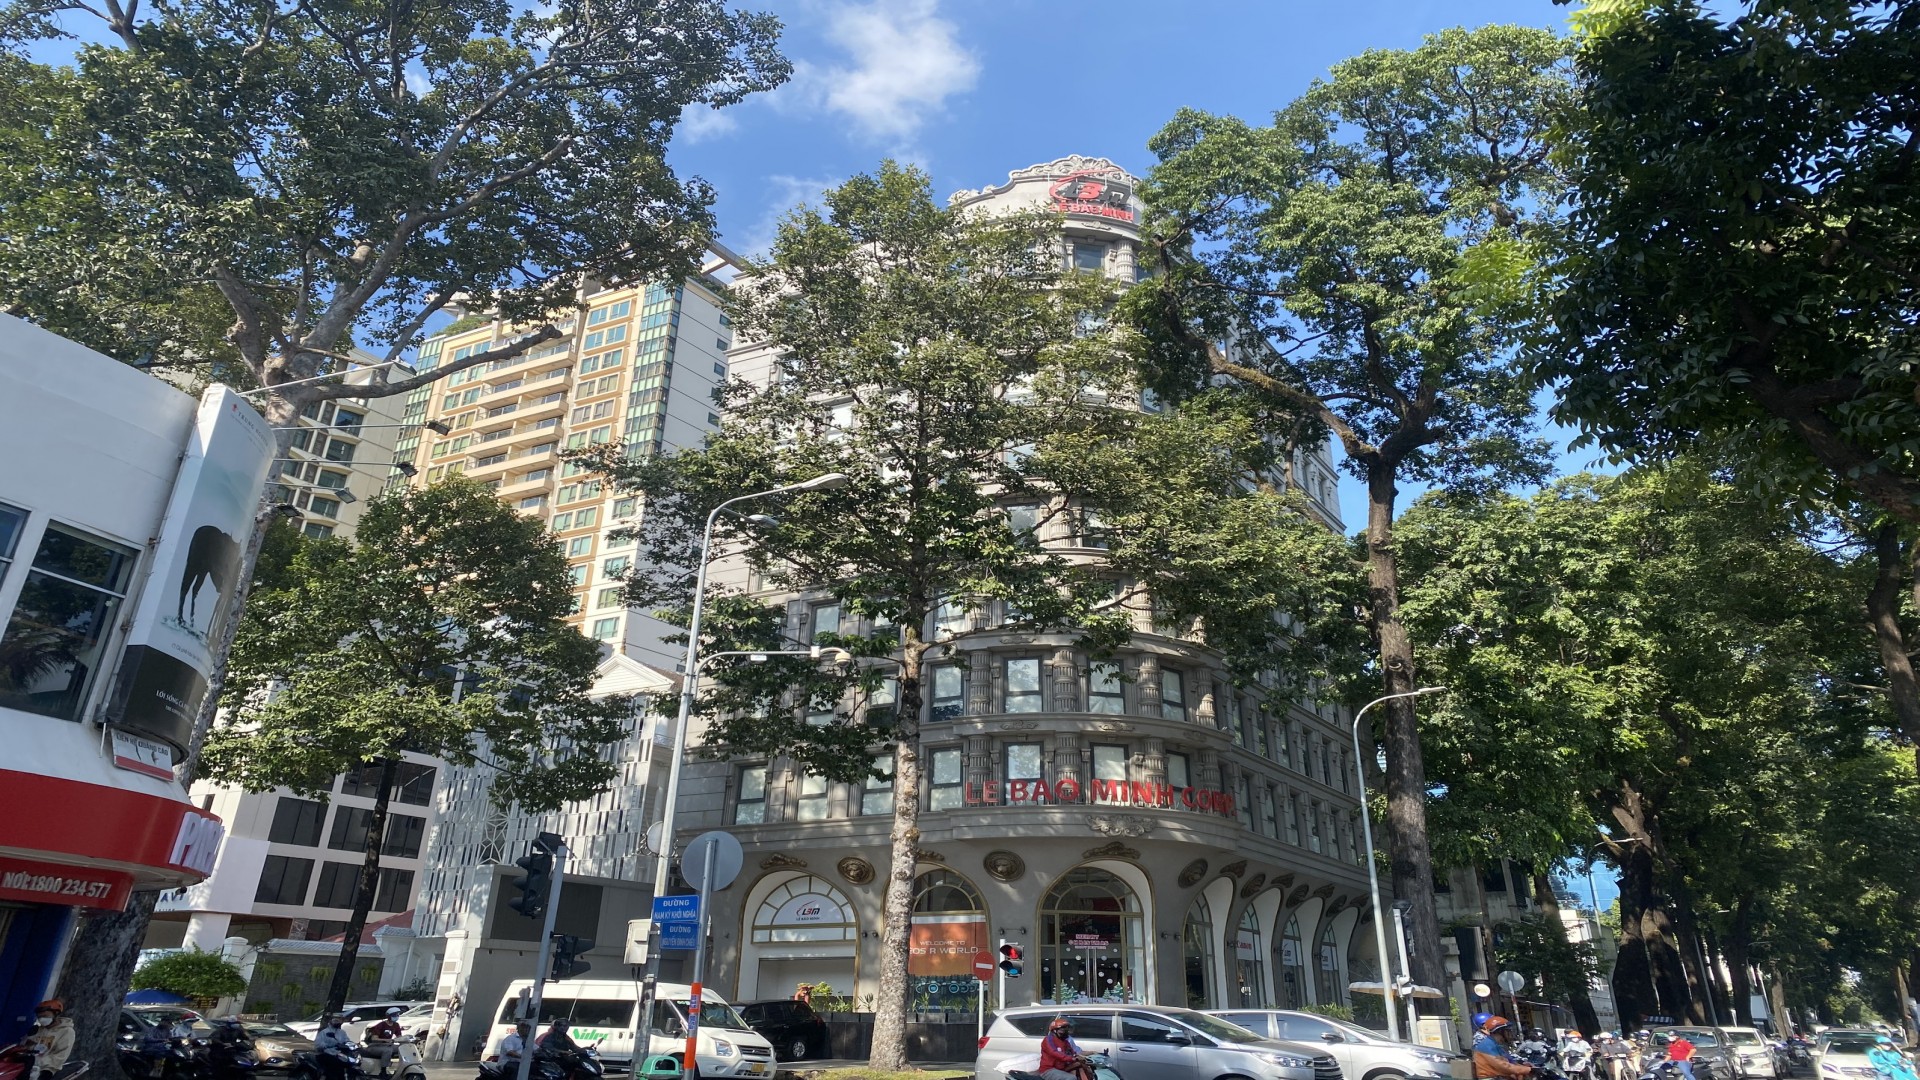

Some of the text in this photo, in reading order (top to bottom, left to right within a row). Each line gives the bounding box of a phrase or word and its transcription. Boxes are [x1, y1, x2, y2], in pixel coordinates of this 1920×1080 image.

[1101, 206, 1134, 221] MINH
[965, 781, 999, 804] LE
[1010, 778, 1080, 802] BAO
[1092, 778, 1174, 808] MINH
[30, 875, 63, 893] 1800
[62, 879, 88, 896] 234
[87, 882, 112, 899] 577
[663, 899, 690, 907] ĐƯỜNG
[670, 925, 692, 934] ĐƯỜNG
[940, 946, 978, 954] WORLD
